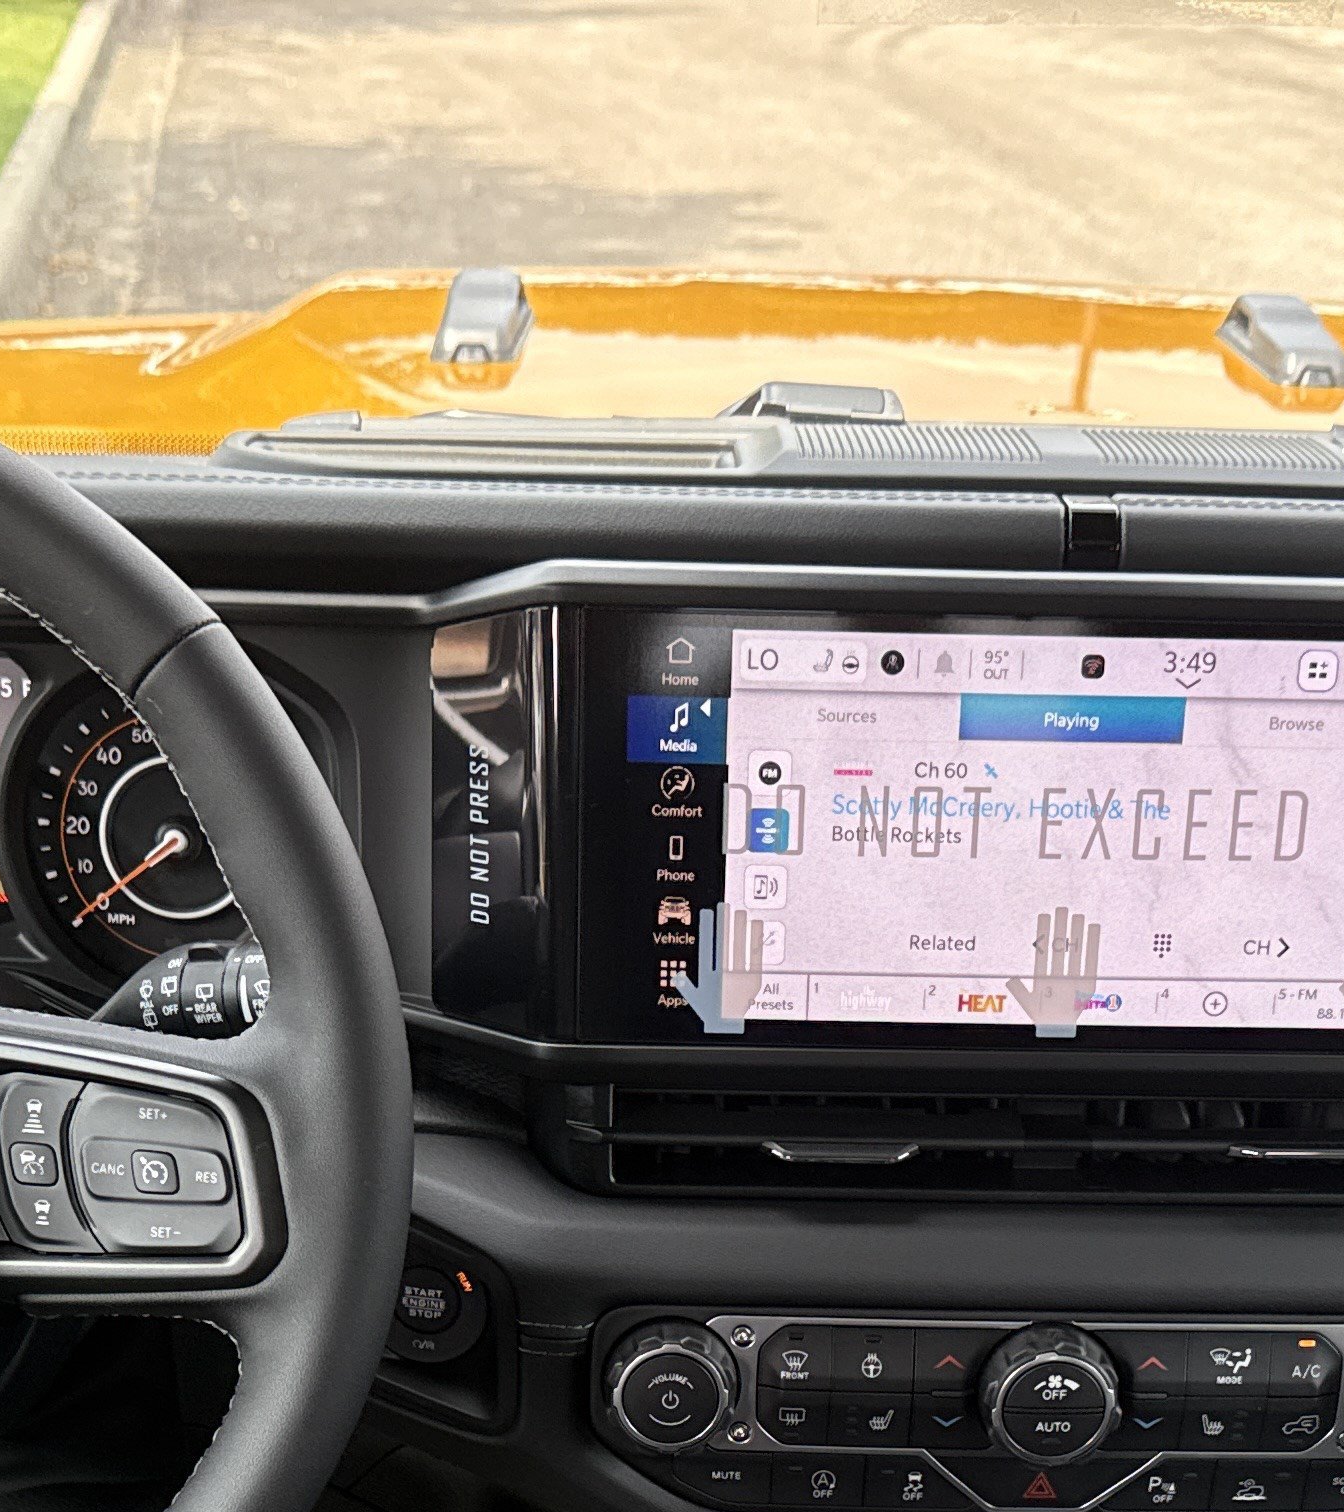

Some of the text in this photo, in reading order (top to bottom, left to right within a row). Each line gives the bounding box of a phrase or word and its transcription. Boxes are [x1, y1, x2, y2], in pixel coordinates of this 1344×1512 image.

[747, 648, 779, 671] LO
[984, 650, 1010, 665] 95°
[1163, 651, 1217, 675] 3:49
[661, 673, 700, 687] Home
[984, 668, 1009, 680] OUT
[817, 708, 877, 725] Sources
[1044, 713, 1100, 731] Playing
[1269, 716, 1325, 733] Browse
[660, 739, 698, 753] Media
[96, 746, 122, 766] 40
[914, 762, 968, 779] Ch 60
[77, 781, 98, 796] 30
[651, 804, 703, 819] Comfort
[66, 816, 91, 835] 20
[858, 784, 993, 859] NOT
[1038, 787, 1310, 863] EXCEED
[468, 744, 491, 925] DO NOT PRESS
[891, 827, 962, 844] Rockets
[77, 859, 94, 874] 10
[656, 868, 696, 882] Phone
[107, 914, 136, 926] MPH
[652, 933, 696, 946] Vehicle
[909, 935, 976, 952] Related
[1242, 939, 1271, 956] CH
[167, 958, 184, 969] ON
[763, 984, 780, 995] All
[928, 985, 937, 996] 2
[1160, 988, 1170, 999] 4
[1297, 988, 1318, 1000] FM
[194, 1002, 218, 1013] REAR
[657, 995, 689, 1009] Apps
[747, 999, 794, 1011] Presets
[957, 994, 1007, 1013] HEAT
[161, 1004, 179, 1016] OFF
[1317, 1008, 1344, 1020] 88.1
[194, 1013, 223, 1024] WIPER
[138, 1107, 168, 1120] SET+
[91, 1162, 125, 1176] CANC
[195, 1171, 218, 1184] RES
[404, 1286, 443, 1298] START
[402, 1297, 446, 1311] ENGINE
[408, 1309, 442, 1319] STOP
[780, 1370, 810, 1380] FRONT
[1292, 1364, 1322, 1379] A/C
[652, 1373, 688, 1386] VOLUME
[1216, 1375, 1243, 1385] MODE
[1042, 1389, 1068, 1401] OFF
[1035, 1421, 1071, 1433] AUTO
[711, 1470, 741, 1480] MUTE
[812, 1489, 833, 1499] OFF
[902, 1490, 924, 1501] OFF
[1152, 1493, 1174, 1503] OFF
